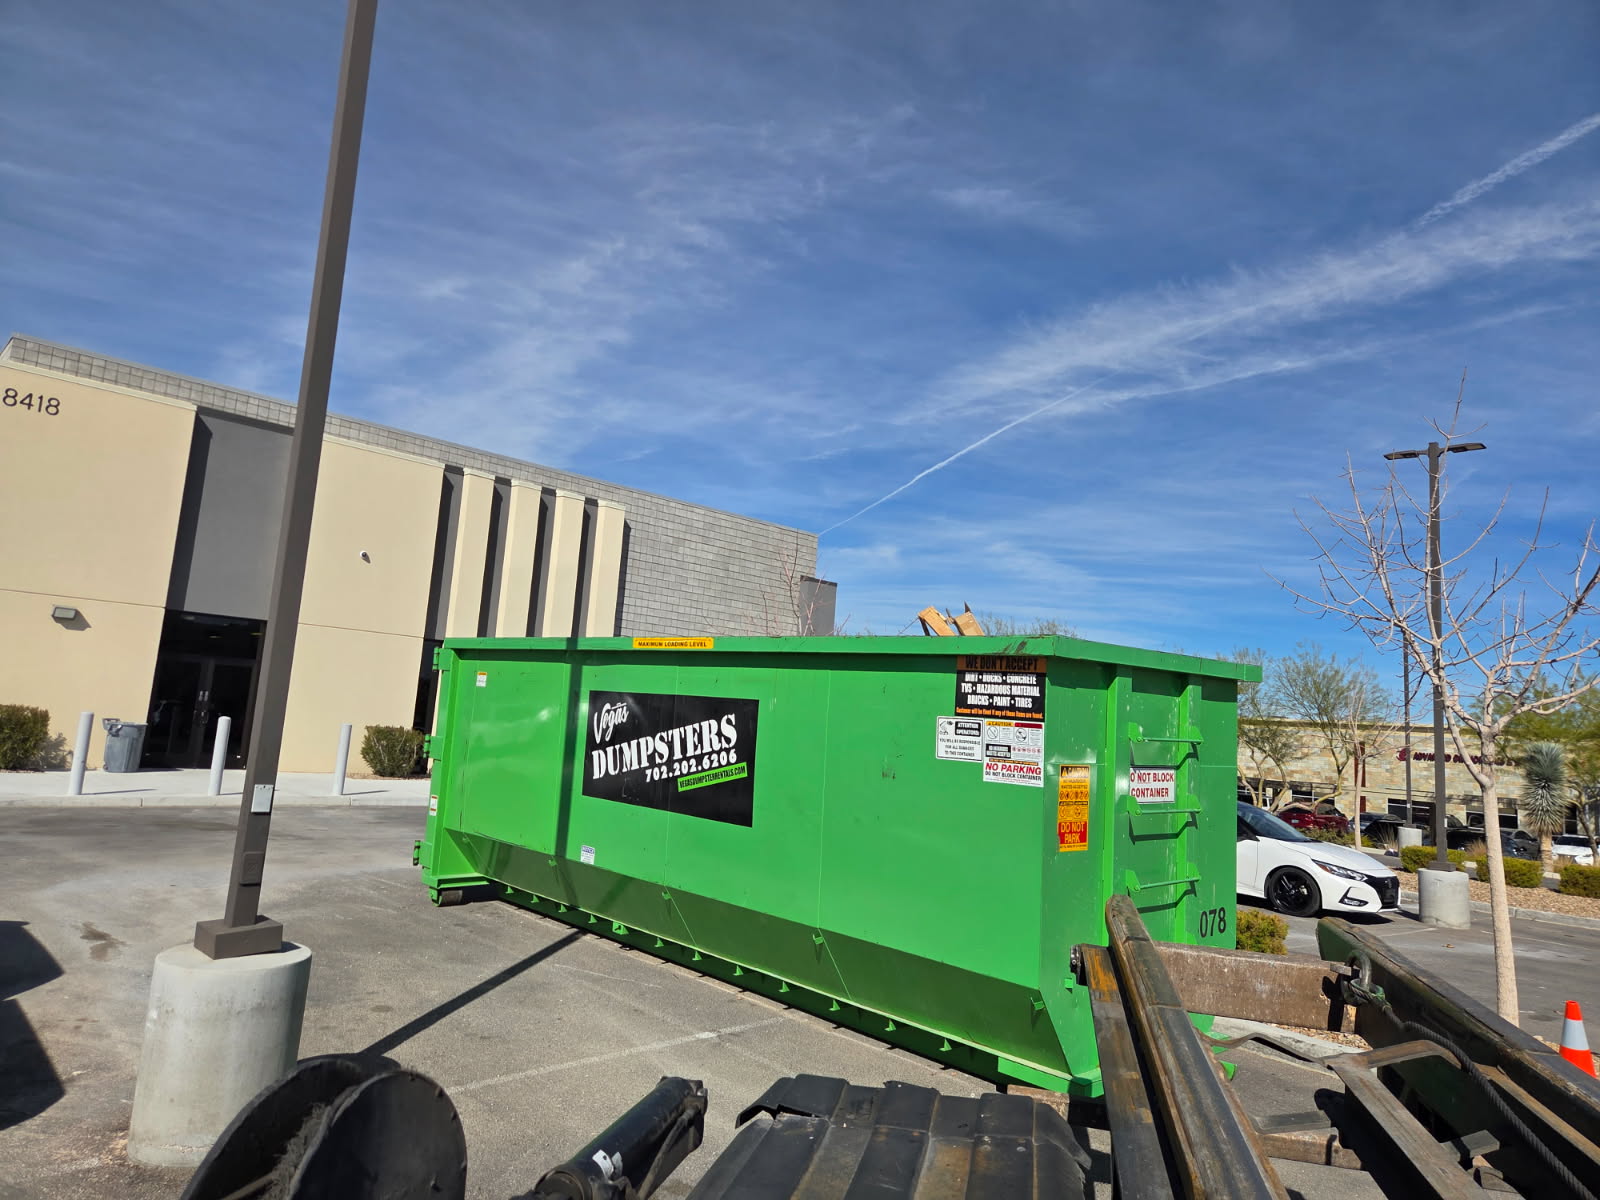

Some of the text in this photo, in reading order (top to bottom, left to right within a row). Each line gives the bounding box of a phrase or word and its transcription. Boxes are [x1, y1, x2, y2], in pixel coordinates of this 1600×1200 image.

[2, 387, 61, 416] 8418
[965, 655, 978, 669] WE
[1006, 656, 1037, 672] ACCEPT
[982, 672, 1003, 683] ROCKS
[1006, 673, 1037, 685] CONCRETE
[976, 683, 1011, 695] HAZARDOUS
[1011, 685, 1040, 697] MATERIAL
[967, 694, 1033, 708] BRICKS PAINT TIRES
[593, 702, 630, 744] Vegas
[591, 713, 738, 779] DUMPSTERS
[645, 748, 738, 783] 702.202.6206
[985, 762, 999, 771] NO
[1001, 763, 1042, 775] PARKING
[679, 765, 746, 788] VEGASDUMPSTERRENTALS.COM
[1017, 773, 1042, 781] CONTAINER
[1137, 772, 1151, 782] NOT
[1152, 772, 1174, 783] BLOCK
[1130, 787, 1169, 798] CONTAINER
[1060, 822, 1086, 833] DO NOT
[1064, 833, 1081, 844] PARK
[1200, 906, 1227, 939] 078
